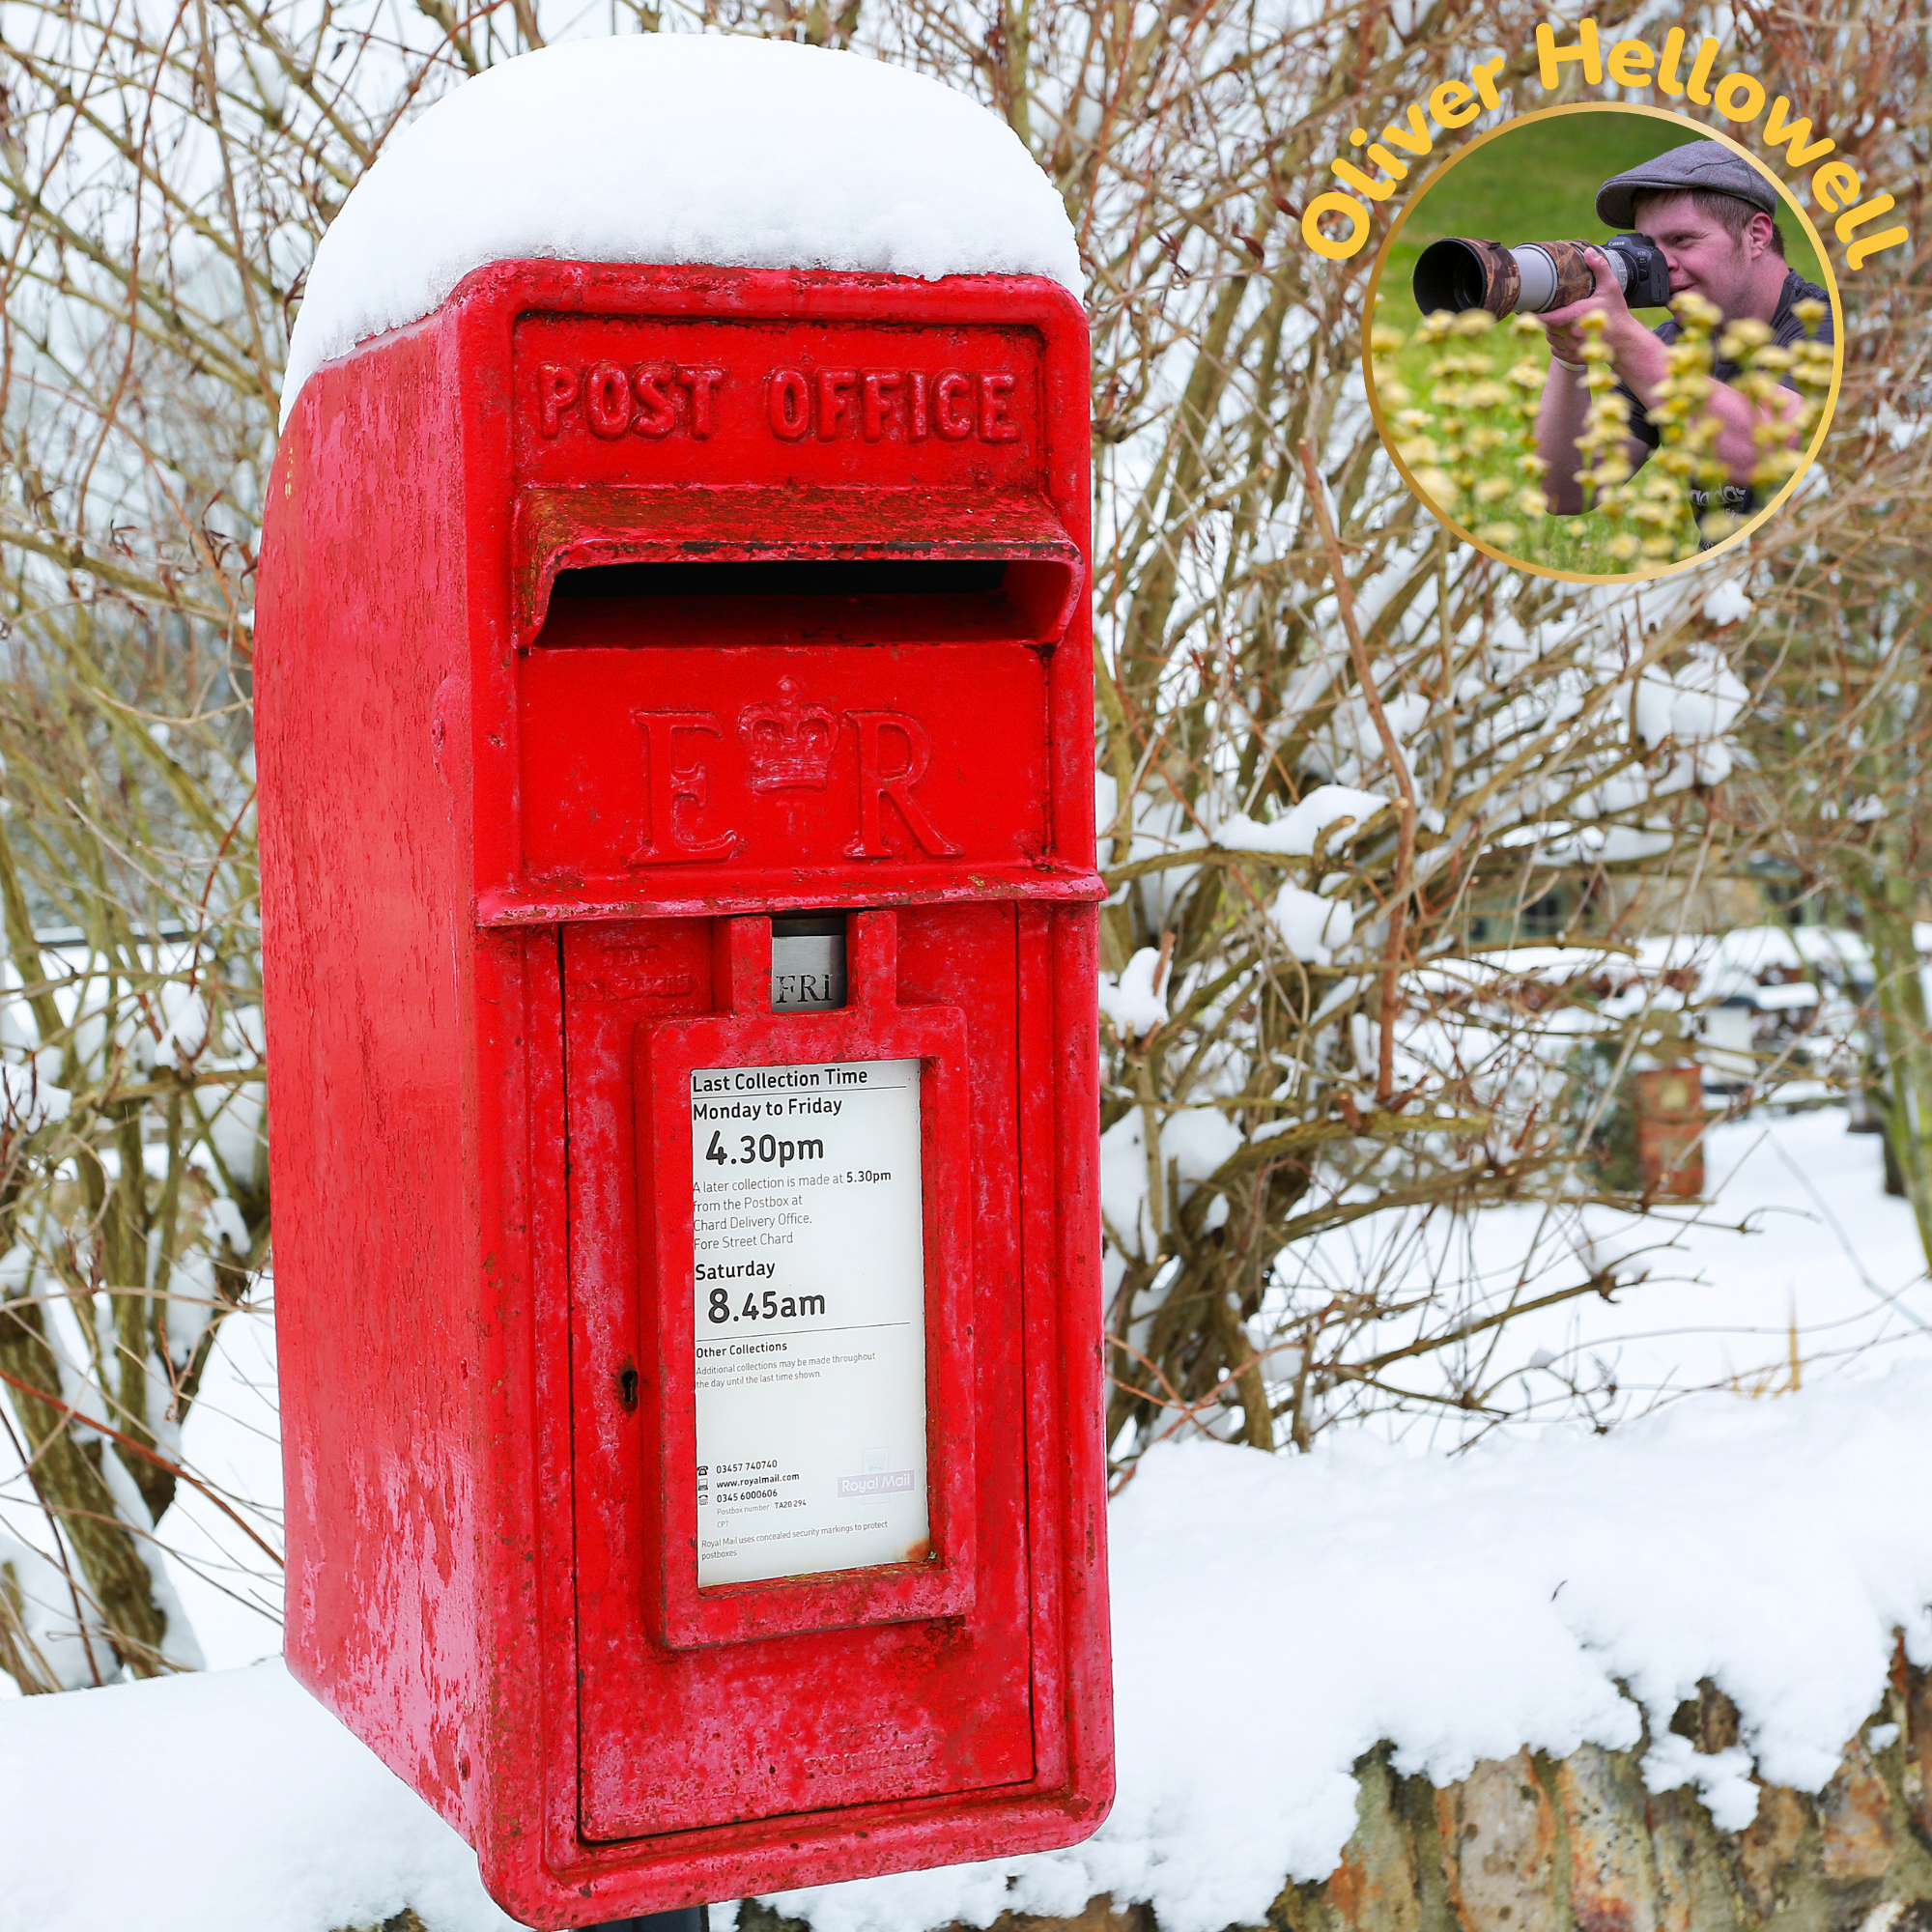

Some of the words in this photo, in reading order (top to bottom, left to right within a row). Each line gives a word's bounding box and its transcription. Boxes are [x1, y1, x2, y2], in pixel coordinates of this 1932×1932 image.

[538, 362, 723, 440] POST
[772, 367, 1019, 443] OFFICE
[629, 708, 746, 865] E
[842, 709, 964, 859] R
[693, 1076, 730, 1092] Last
[735, 1070, 819, 1090] Collection
[824, 1067, 867, 1086] Time
[693, 1101, 761, 1121] Monday
[766, 1101, 783, 1116] to
[788, 1096, 842, 1116] Friday
[705, 1130, 824, 1168] 4.30pm
[694, 1181, 700, 1193] A
[703, 1181, 728, 1193] later
[732, 1177, 784, 1191] collection
[787, 1176, 795, 1187] is
[799, 1174, 829, 1186] made
[833, 1174, 843, 1184] at
[846, 1170, 892, 1183] 5.30pm
[694, 1201, 721, 1212] from
[724, 1199, 741, 1210] the
[744, 1196, 789, 1209] Postbox
[792, 1195, 803, 1206] at
[694, 1218, 727, 1232] Chard
[730, 1216, 776, 1229] Delivery
[695, 1237, 720, 1251] Fore
[723, 1236, 757, 1248] Street
[760, 1232, 793, 1246] Chard
[696, 1259, 776, 1280] Saturday
[708, 1288, 826, 1324] 8.45am
[696, 1348, 726, 1358] Other
[729, 1342, 787, 1355] Collections
[696, 1364, 735, 1376] Additional
[737, 1361, 778, 1373] collections
[780, 1360, 796, 1369] may
[797, 1358, 807, 1367] be
[809, 1356, 831, 1365] made
[832, 1352, 876, 1364] throughout
[696, 1380, 709, 1389] the
[711, 1379, 724, 1388] day
[726, 1377, 744, 1386] until
[746, 1376, 758, 1384] the
[760, 1374, 774, 1383] last
[776, 1372, 793, 1381] time
[795, 1371, 822, 1379] shown.
[716, 1463, 744, 1474] 03457
[746, 1460, 778, 1471] 740740
[717, 1473, 800, 1489] www.royalmail.com
[841, 1477, 878, 1493] Royal
[882, 1473, 910, 1488] Mail
[717, 1492, 738, 1503] 0345
[740, 1489, 778, 1500] 6000606
[717, 1506, 743, 1516] Postbox
[744, 1504, 770, 1513] number
[774, 1501, 792, 1510] TA20
[701, 1539, 722, 1549] Royal
[723, 1536, 737, 1546] Mail
[756, 1530, 791, 1542] concealed
[792, 1527, 820, 1538] security
[821, 1524, 853, 1535] markings
[863, 1520, 888, 1532] protect
[701, 1548, 737, 1561] postboxes
